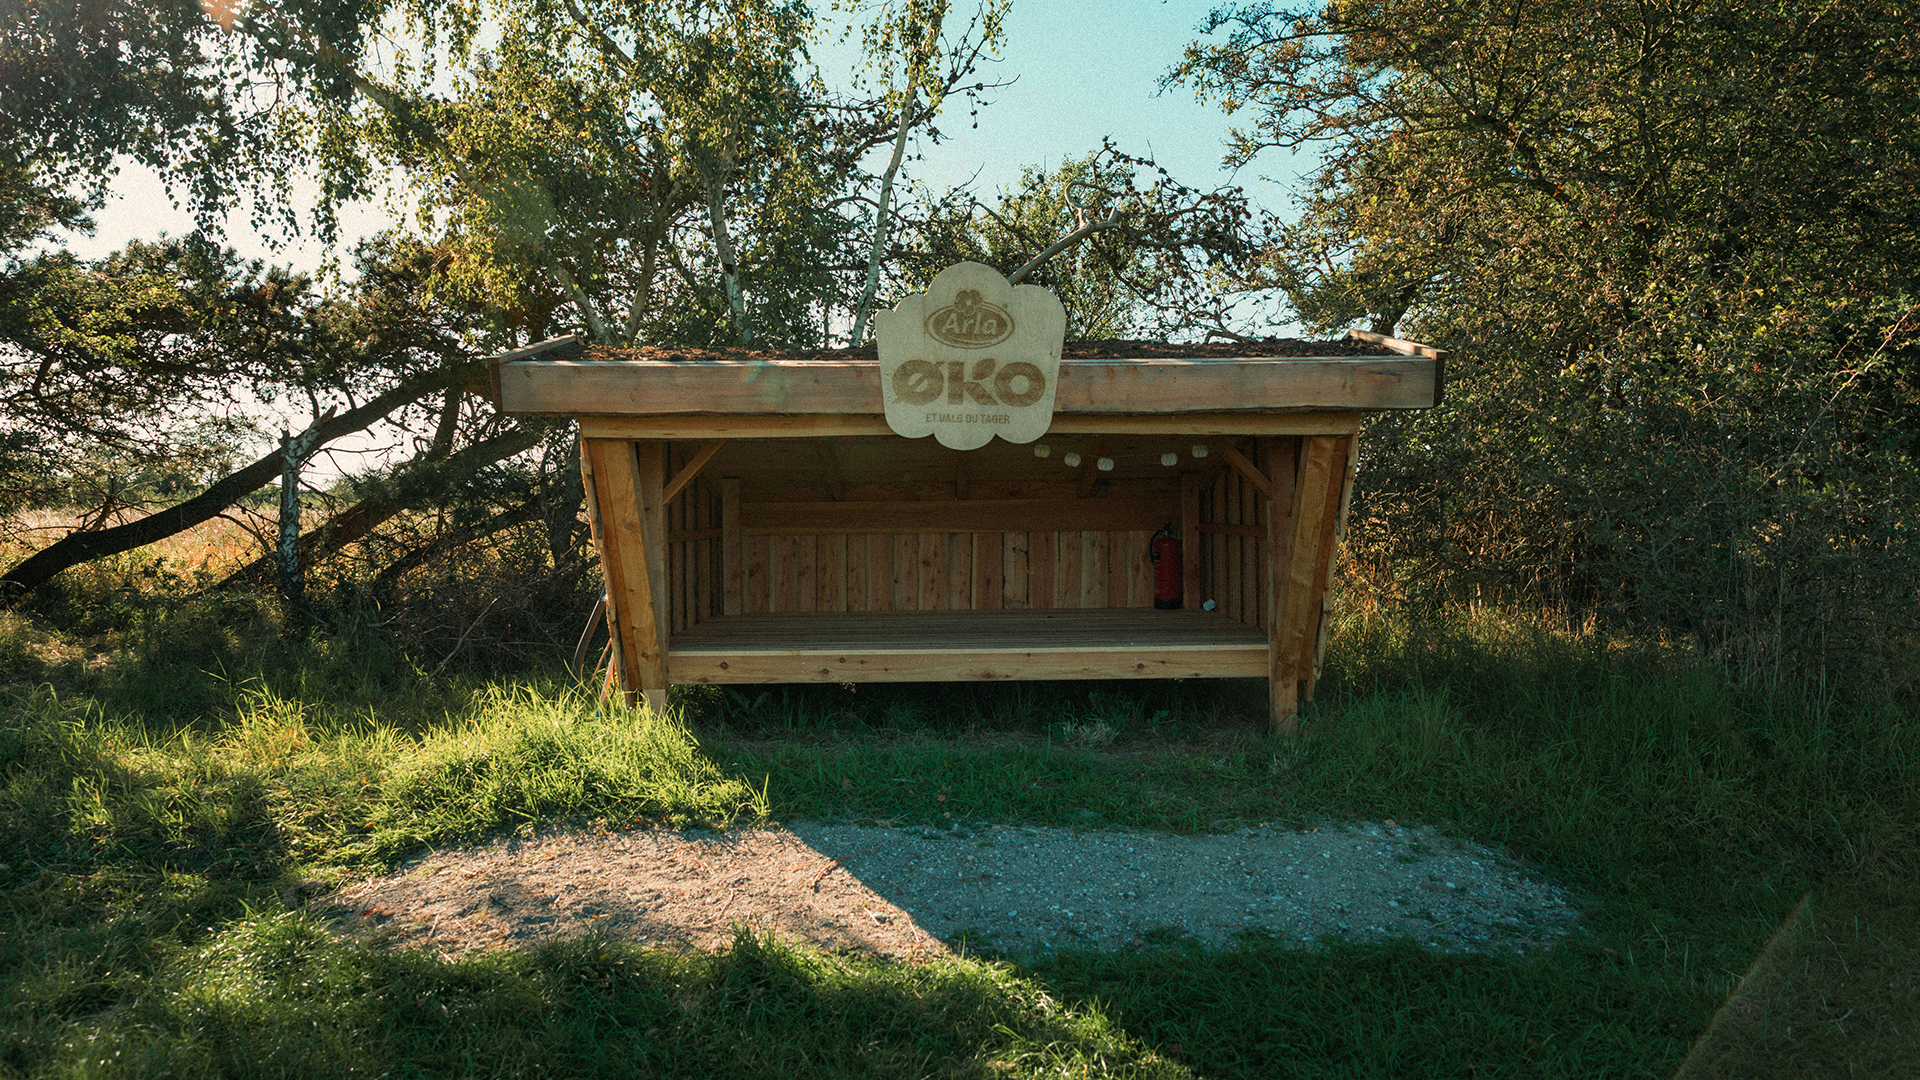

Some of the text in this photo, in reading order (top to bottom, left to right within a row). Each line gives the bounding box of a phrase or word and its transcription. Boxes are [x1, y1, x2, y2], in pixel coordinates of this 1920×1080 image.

[941, 311, 999, 336] Arla
[891, 358, 1046, 408] ØKO
[926, 413, 936, 423] ET
[939, 413, 963, 423] VALG
[980, 414, 1010, 424] TAGER
